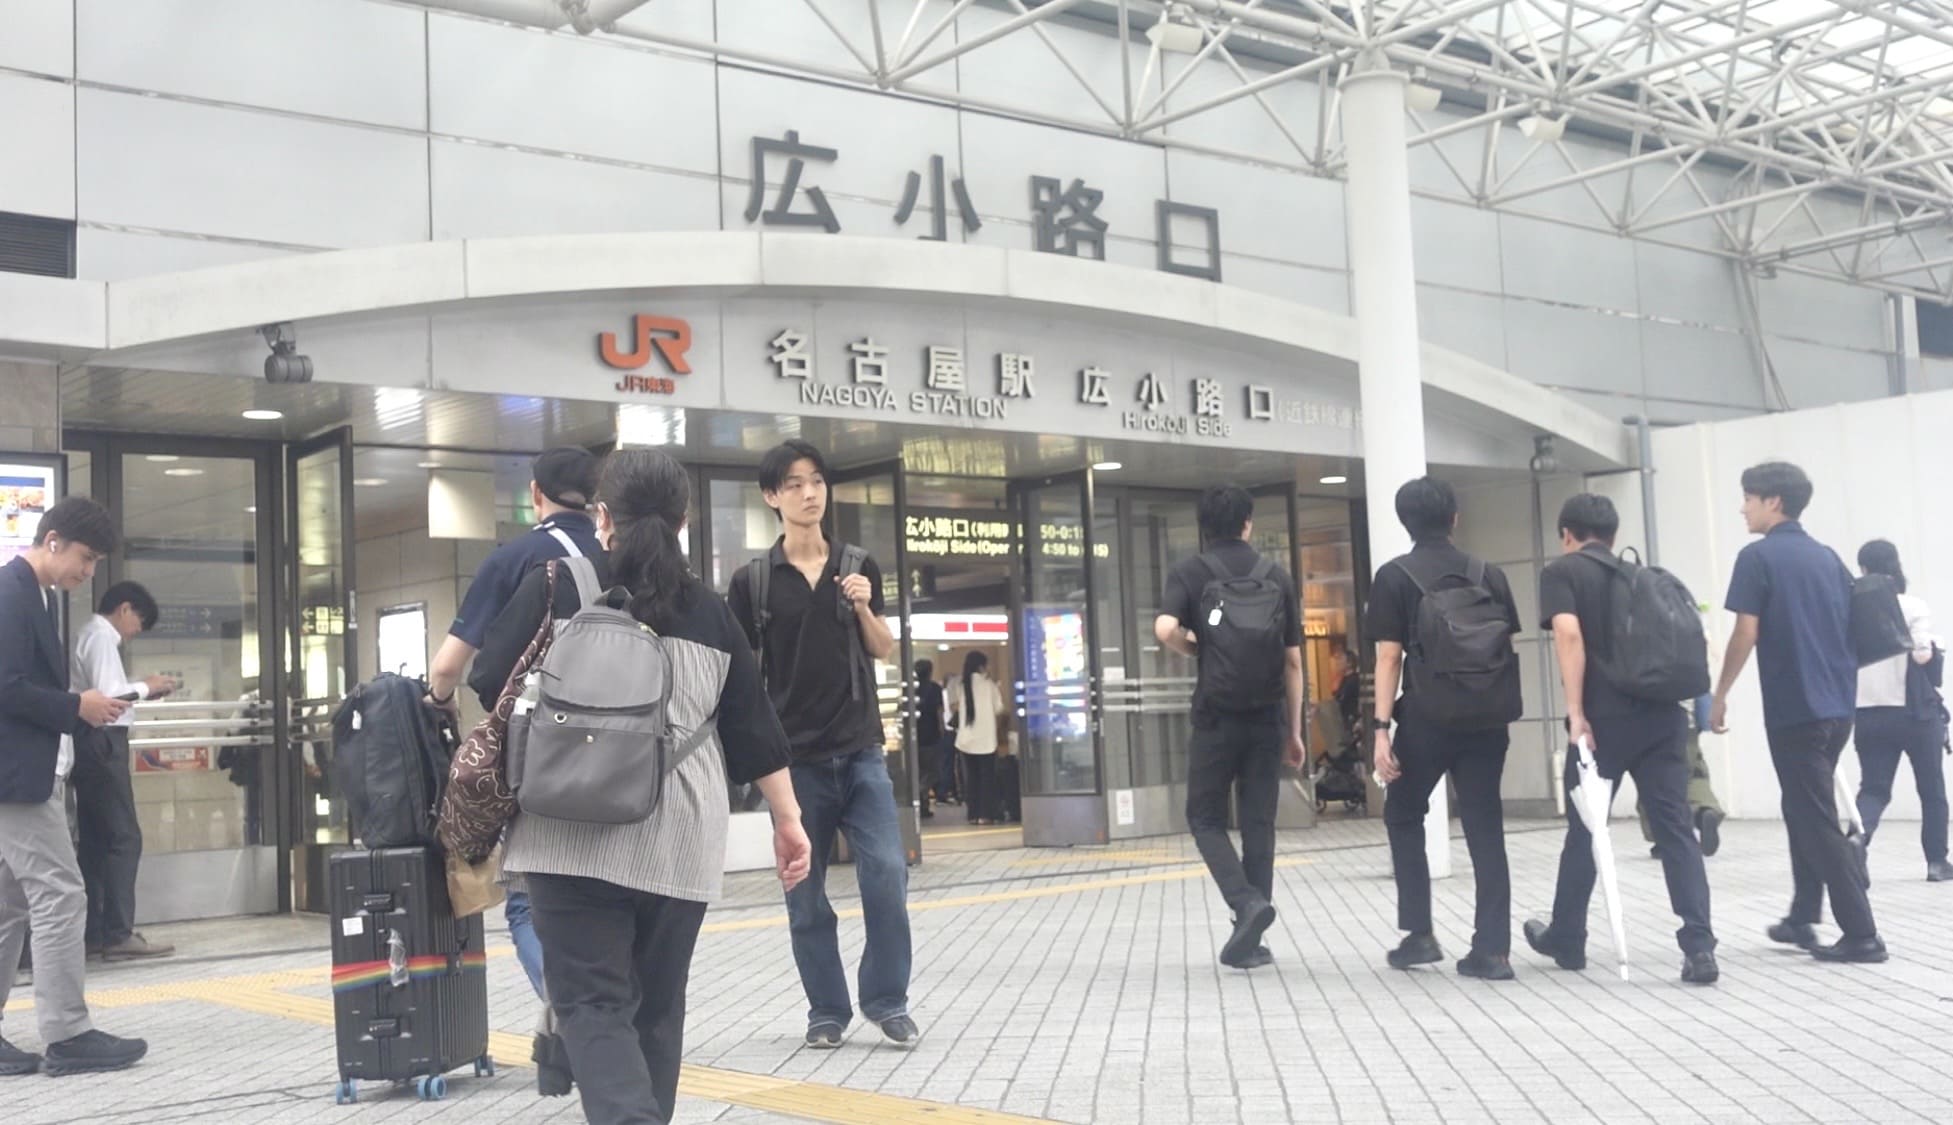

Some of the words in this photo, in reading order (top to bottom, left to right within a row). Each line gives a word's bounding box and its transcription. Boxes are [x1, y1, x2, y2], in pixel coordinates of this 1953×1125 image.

[744, 130, 1222, 282] 広小路口
[601, 314, 692, 374] JR
[770, 328, 1036, 398] 名古屋駅
[1083, 365, 1274, 420] 広小路口
[801, 383, 898, 410] NAGOYA
[911, 391, 1008, 418] STATION
[1124, 411, 1189, 434] Hirokoji
[1197, 418, 1233, 438] Side
